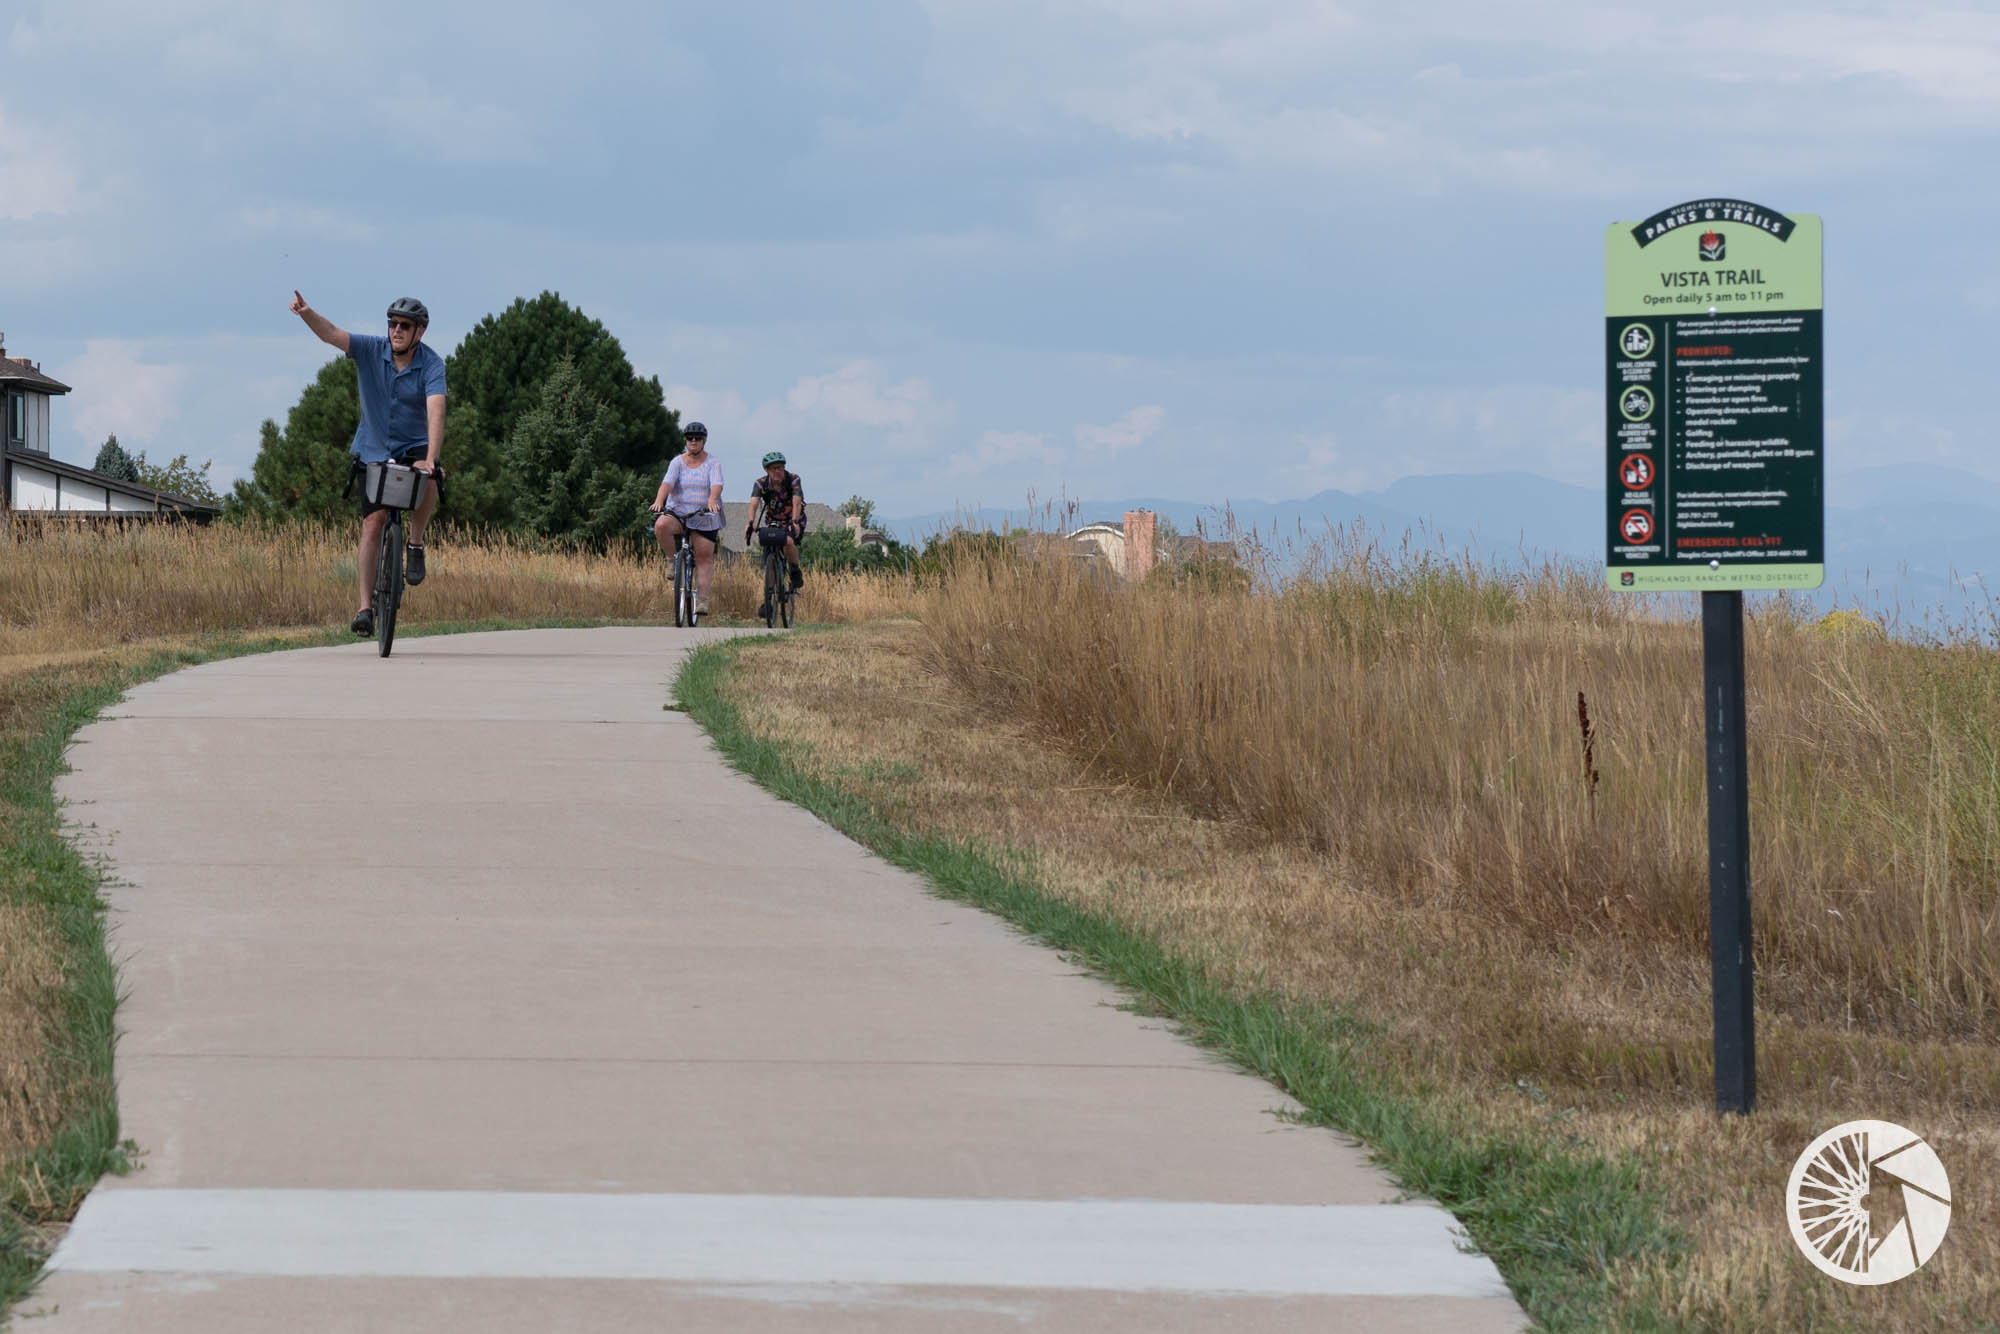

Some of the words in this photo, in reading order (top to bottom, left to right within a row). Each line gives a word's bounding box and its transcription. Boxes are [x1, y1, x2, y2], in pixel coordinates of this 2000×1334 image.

[1670, 202, 1723, 216] HIGHLANDS
[1726, 202, 1756, 213] RANCH
[1645, 211, 1697, 239] PARKS
[1705, 208, 1715, 219] &
[1723, 209, 1781, 233] TRAILS
[1661, 272, 1710, 287] VISTA
[1716, 270, 1765, 285] TRAIL
[1644, 295, 1672, 307] Open
[1676, 292, 1702, 305] daily
[1706, 293, 1712, 302] 5
[1735, 293, 1746, 301] to
[1750, 291, 1762, 300] 11
[1766, 292, 1784, 303] pm
[1685, 375, 1722, 383] Damaging
[1767, 373, 1800, 381] property
[1686, 386, 1716, 394] Littering
[1727, 385, 1761, 393] dumping
[1685, 429, 1713, 438] Golfing
[1725, 439, 1760, 448] harassing
[1717, 450, 1751, 458] paintball,
[1742, 538, 1763, 546] CALL
[1766, 537, 1782, 546] 911
[1638, 575, 1690, 583] HIGHLANDS
[1730, 574, 1763, 582] METRO
[1767, 574, 1809, 582] DISTRICT
